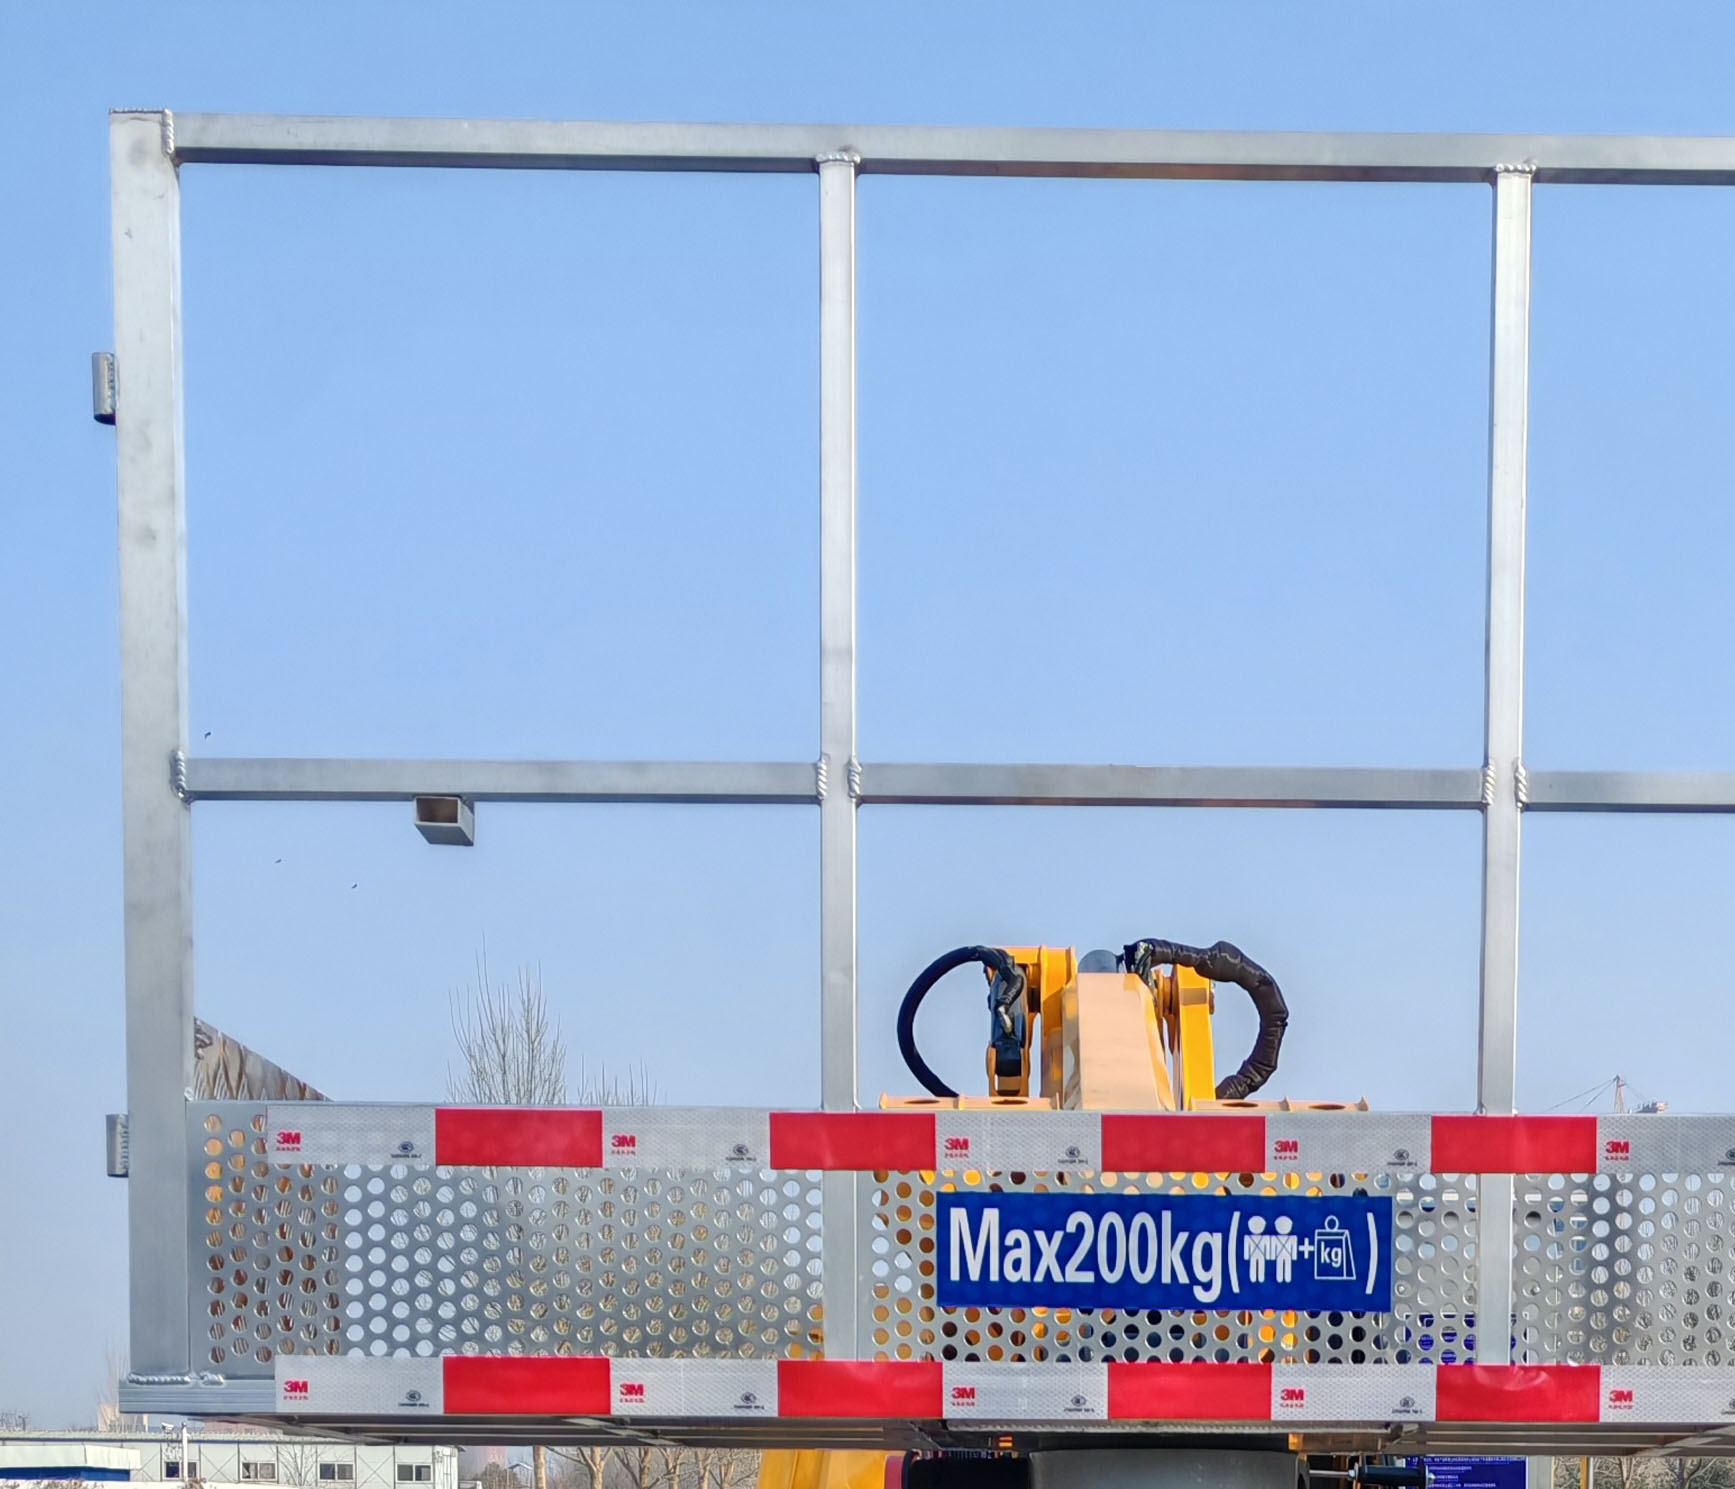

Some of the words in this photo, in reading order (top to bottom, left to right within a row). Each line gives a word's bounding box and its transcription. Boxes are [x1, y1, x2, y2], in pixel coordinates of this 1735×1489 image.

[277, 1131, 301, 1144] 3M
[612, 1133, 636, 1146] 3M
[945, 1137, 969, 1150] 3M
[1274, 1140, 1298, 1153] 3M
[1605, 1140, 1629, 1153] 3M
[1320, 1240, 1342, 1268] kg
[284, 1380, 308, 1393] 3M
[620, 1383, 644, 1396] 3M
[951, 1386, 975, 1399] 3M
[1280, 1387, 1304, 1400] 3M
[1609, 1389, 1633, 1402] 3M
